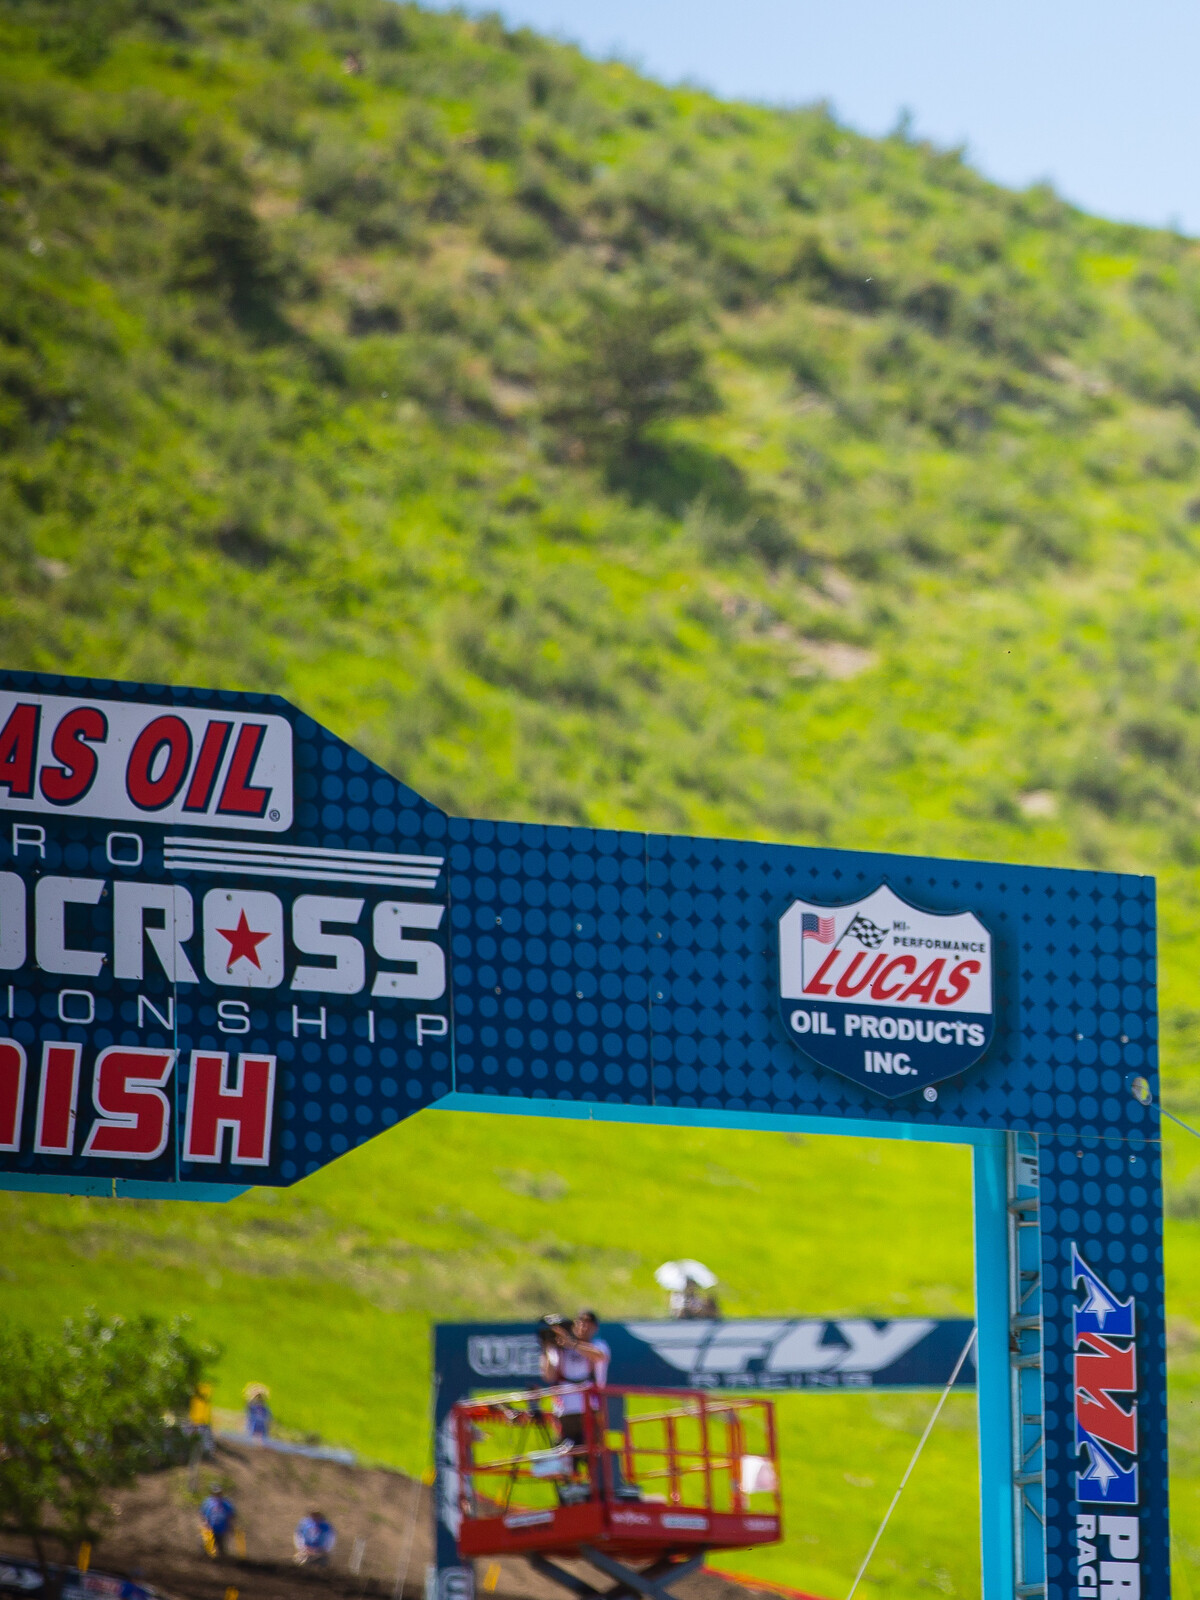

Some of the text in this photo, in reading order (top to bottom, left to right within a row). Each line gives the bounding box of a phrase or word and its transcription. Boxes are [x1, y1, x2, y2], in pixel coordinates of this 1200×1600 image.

[0, 702, 273, 818] AS OIL
[893, 936, 986, 953] PERFORMANCE
[803, 948, 982, 1006] LUCAS
[790, 1009, 985, 1047] OIL PRODUCTS
[864, 1050, 918, 1075] INC.
[622, 1319, 938, 1373] FLY
[1071, 1241, 1139, 1505] AMA
[1076, 1514, 1097, 1597] RACI
